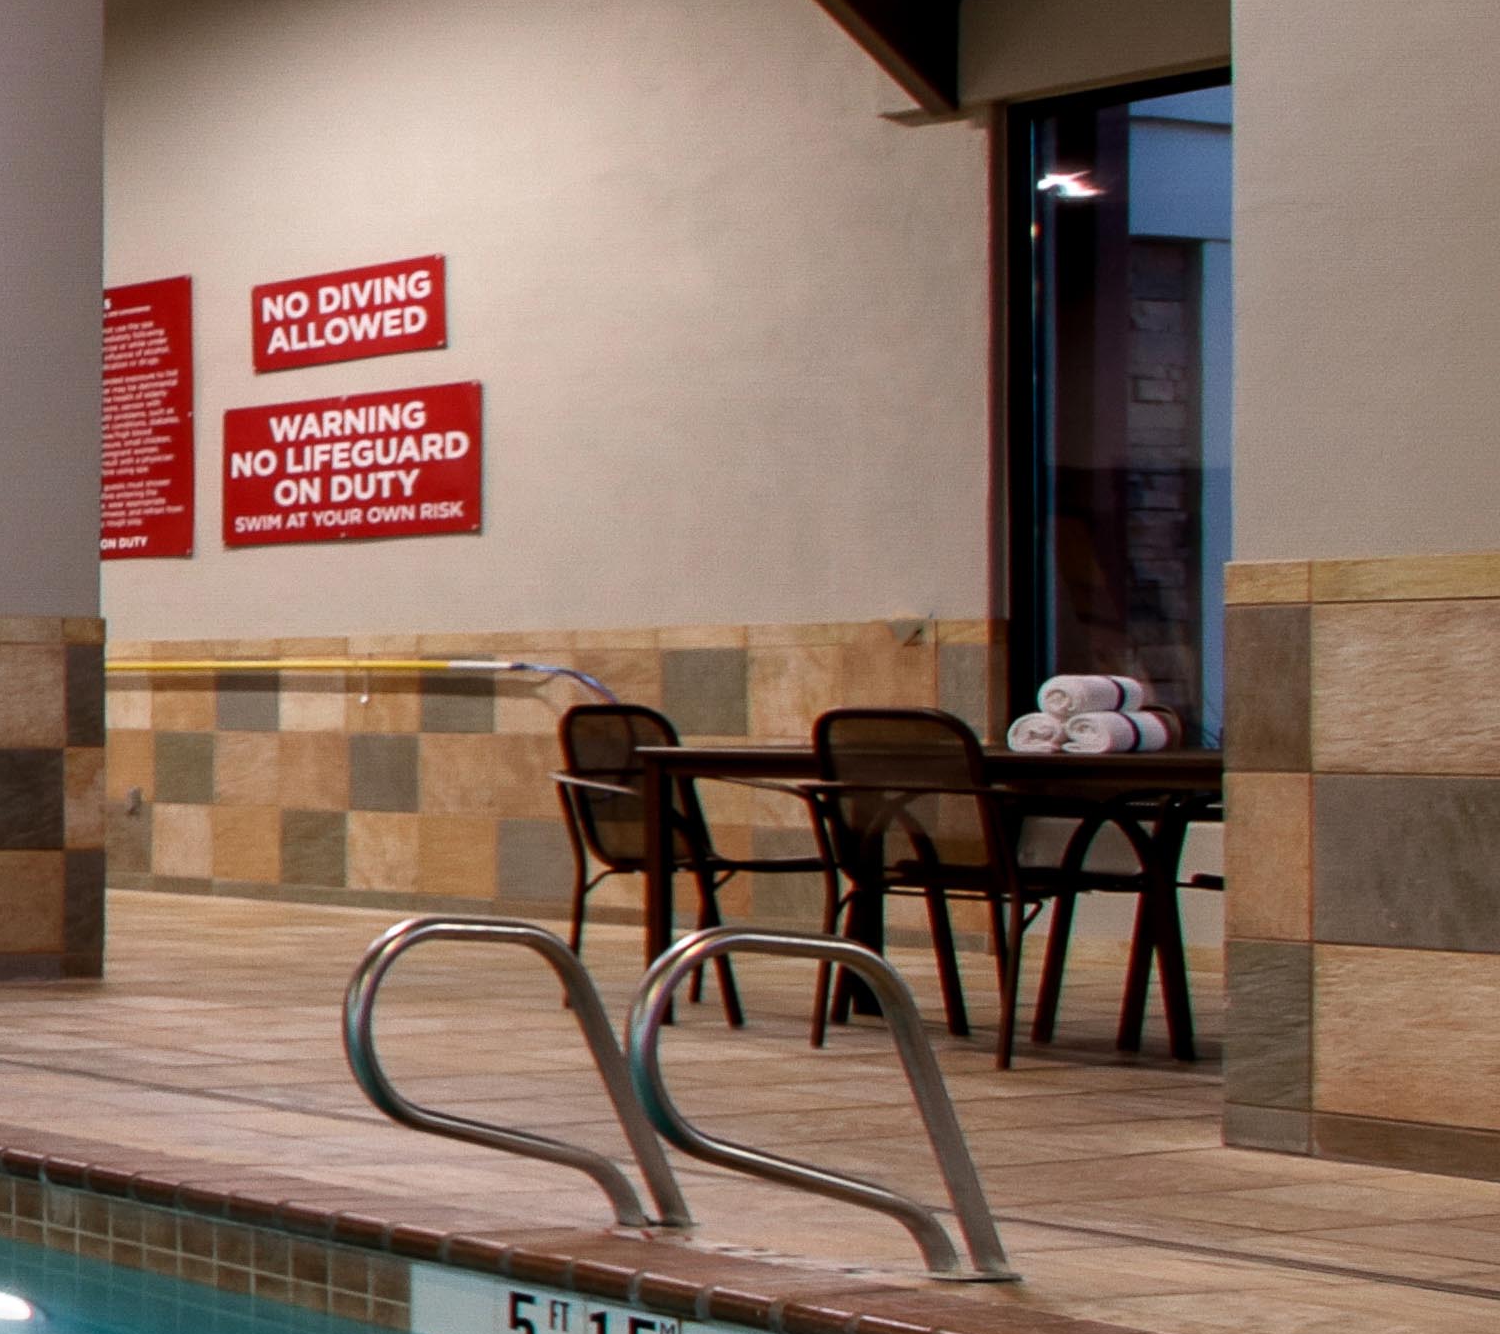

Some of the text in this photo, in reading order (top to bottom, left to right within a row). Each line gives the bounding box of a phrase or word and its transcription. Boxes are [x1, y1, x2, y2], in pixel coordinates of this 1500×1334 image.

[262, 270, 432, 323] NO DIVING
[267, 305, 427, 355] ALLOWED
[269, 400, 426, 444] WARNING
[231, 430, 470, 479] NO LIFEGUARD
[273, 468, 420, 506] ON DUTY
[235, 501, 464, 533] SWIM AT YOUR OWN RISK
[100, 536, 148, 550] ON DUTY
[550, 1300, 570, 1333] FT
